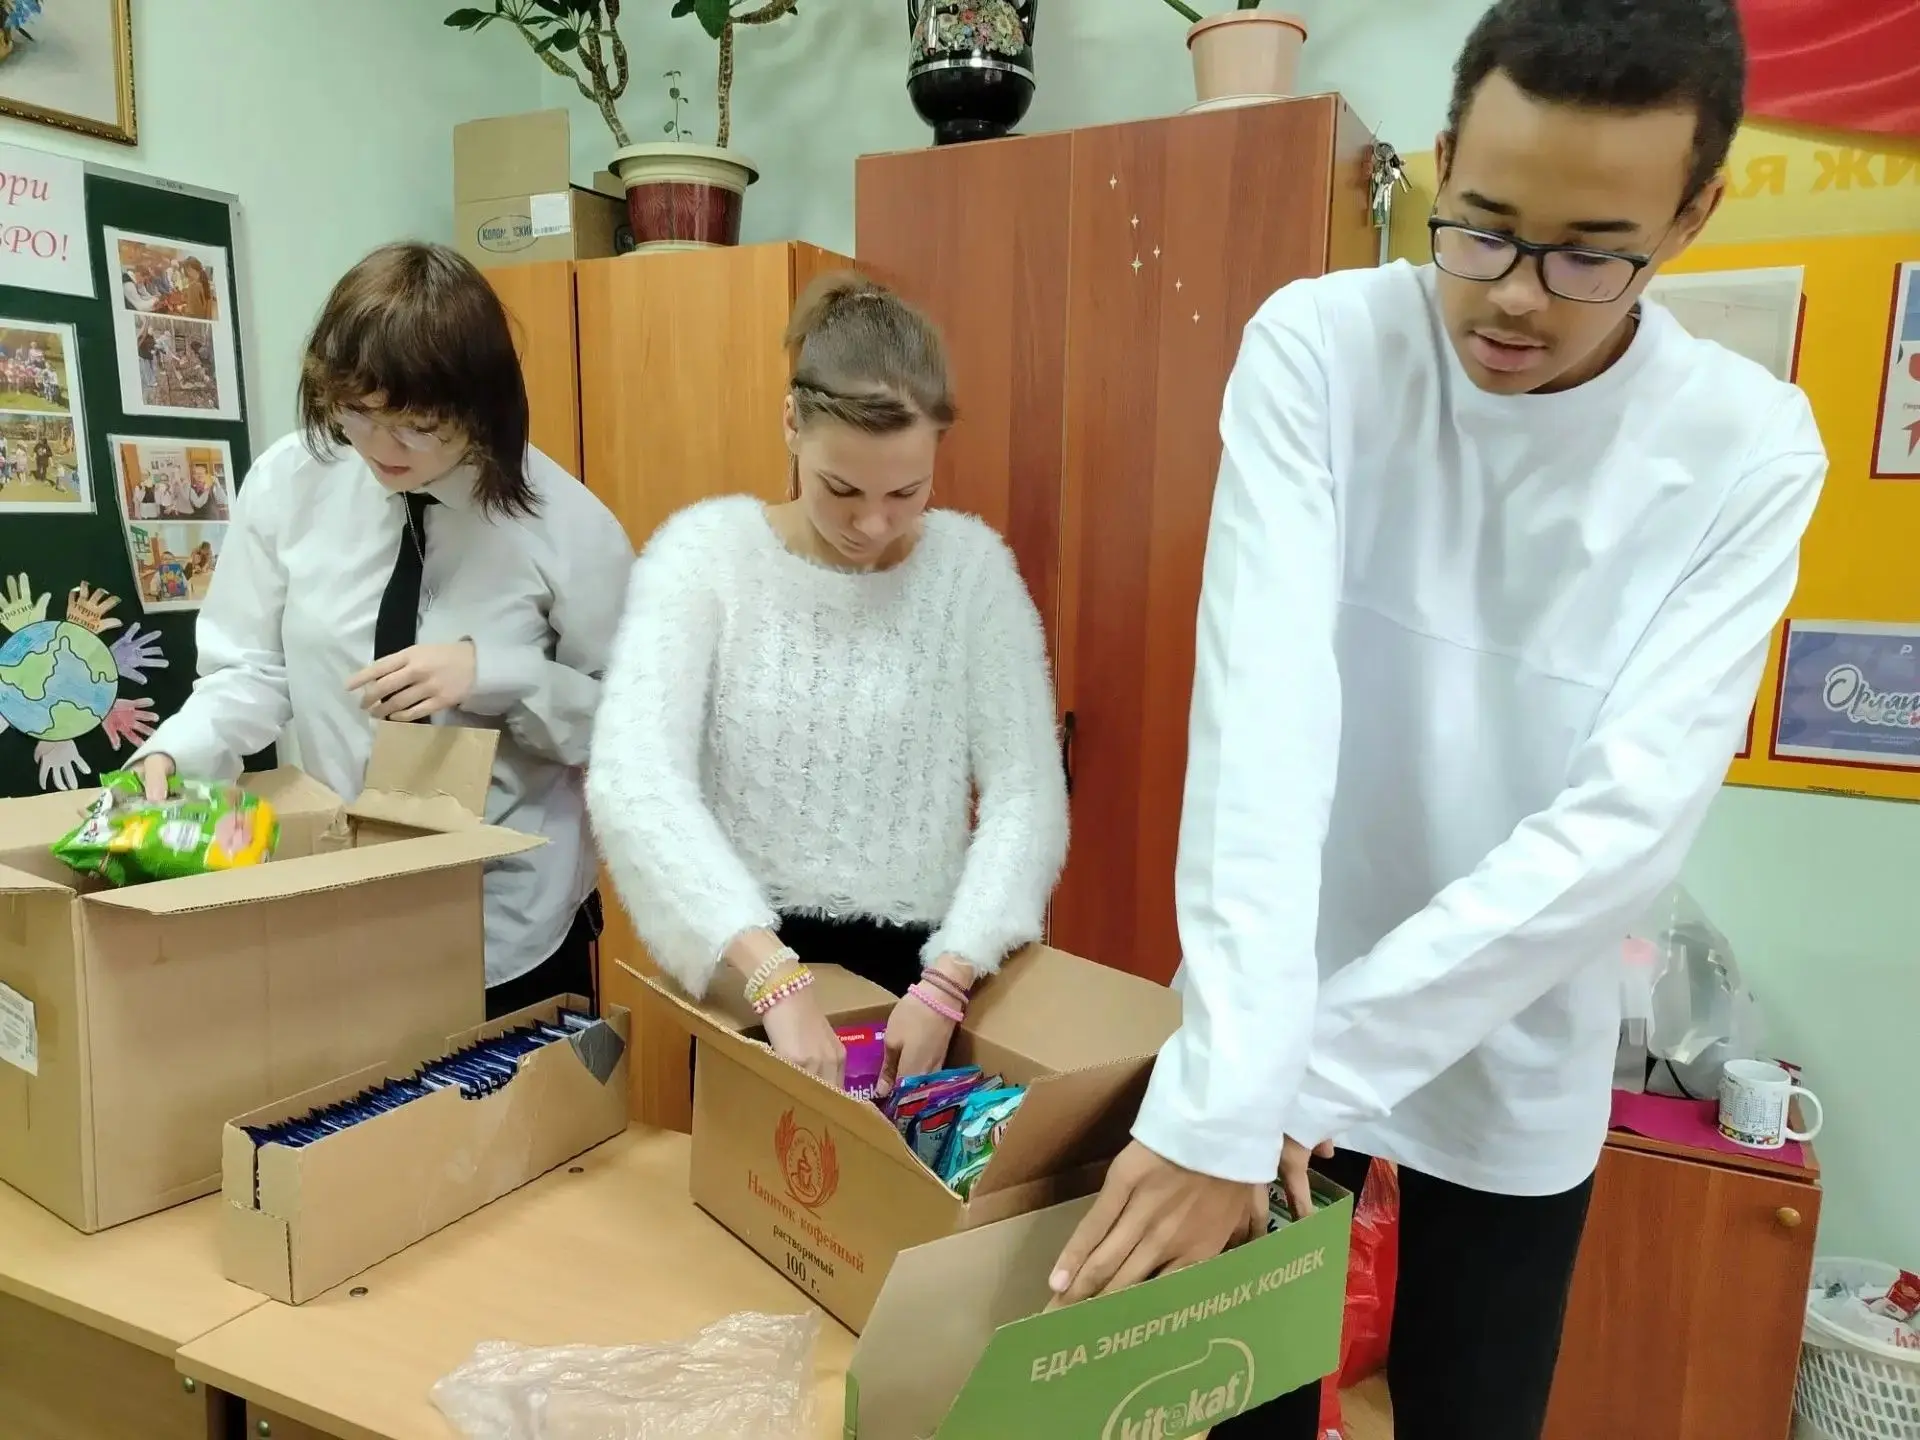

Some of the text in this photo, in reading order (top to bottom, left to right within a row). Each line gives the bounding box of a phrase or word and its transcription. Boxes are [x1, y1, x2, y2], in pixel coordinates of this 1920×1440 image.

[0, 172, 49, 205] ри
[0, 224, 68, 261] РО!
[845, 1083, 877, 1101] hisk
[748, 1169, 864, 1273] Напиток кофейный
[773, 1225, 835, 1278] растворимый
[786, 1252, 820, 1293] 100 г.
[1031, 1246, 1326, 1382] ЕДА ЭНЕРГИЧНЫХ КОШЕК
